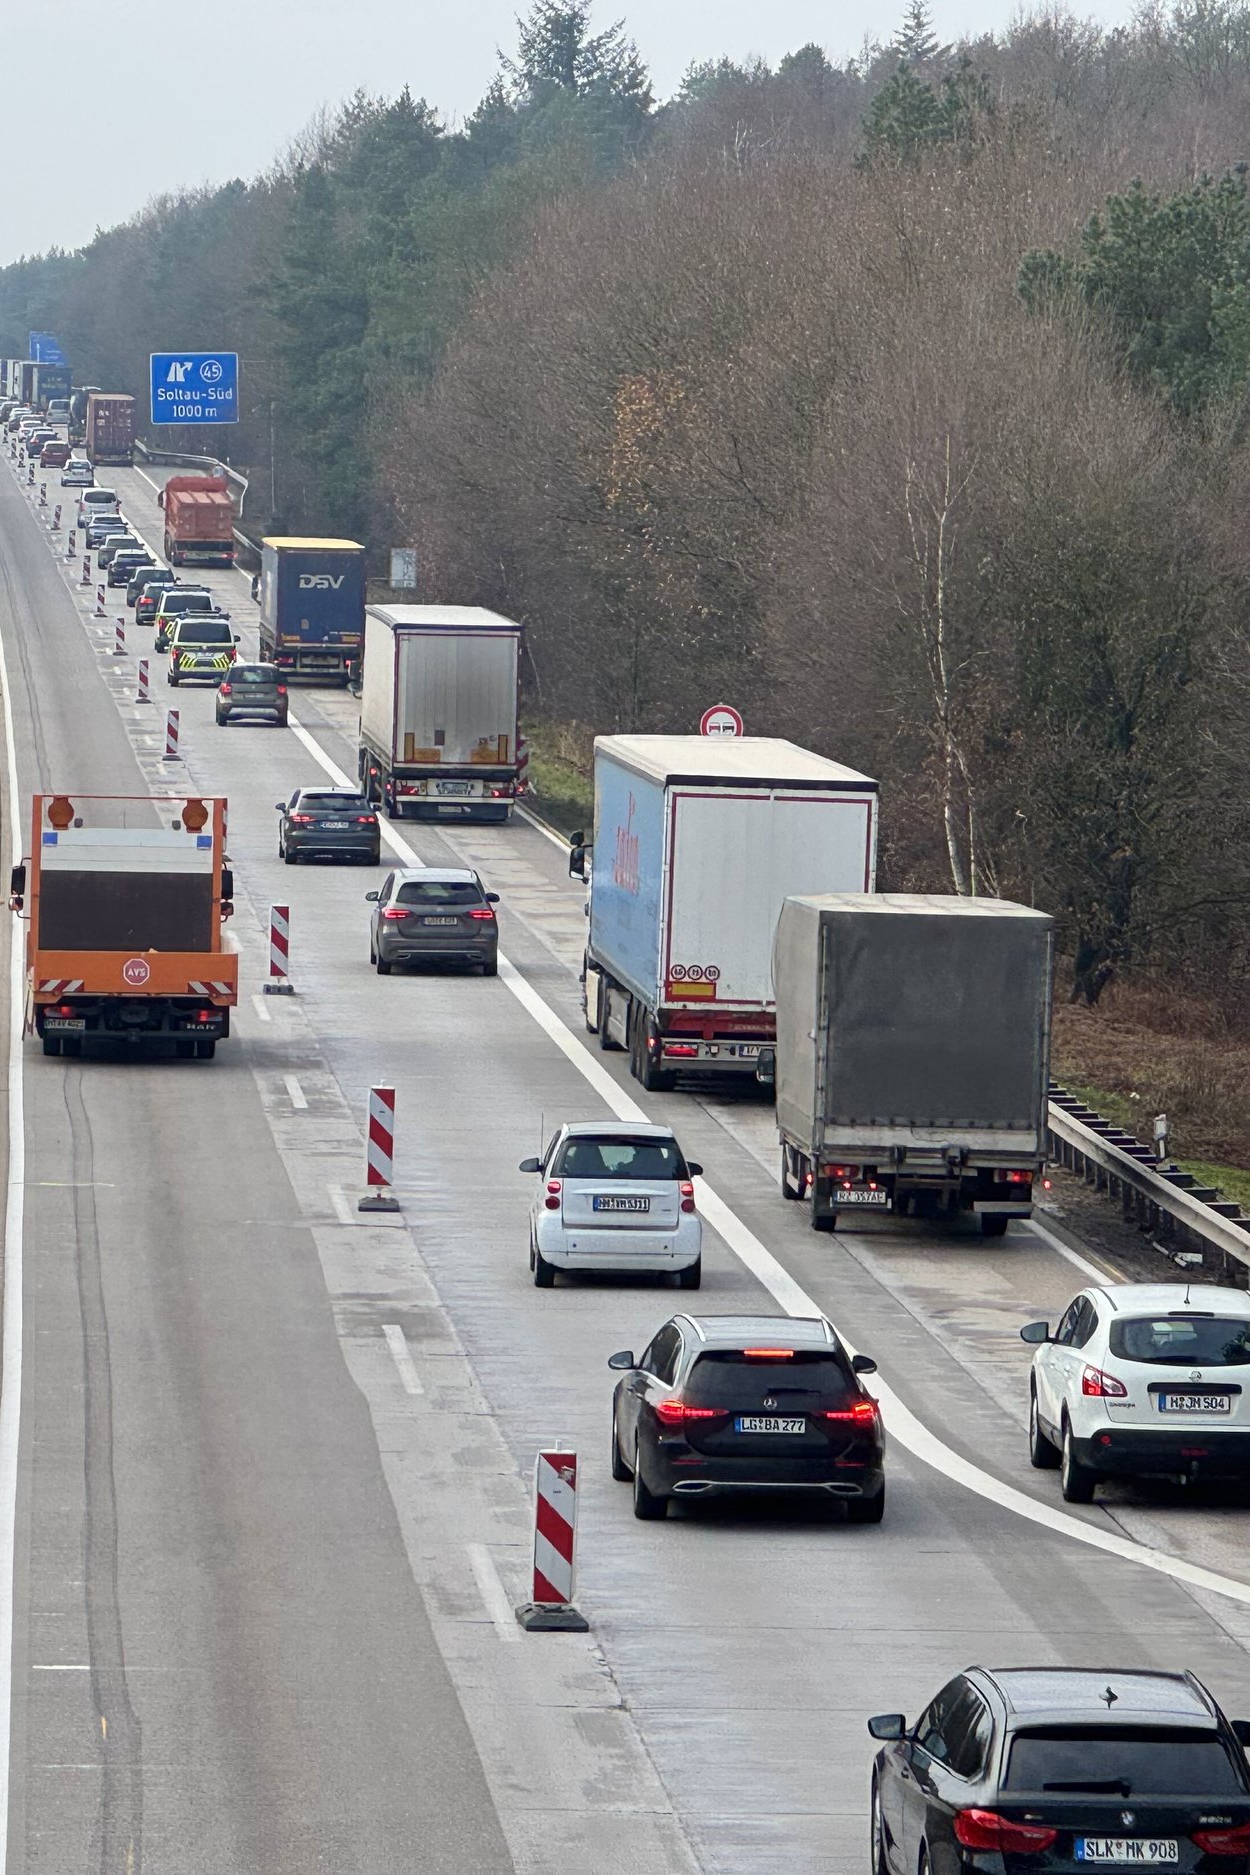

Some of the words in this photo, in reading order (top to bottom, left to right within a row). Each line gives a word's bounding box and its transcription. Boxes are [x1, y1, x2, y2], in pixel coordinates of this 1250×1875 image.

[203, 365, 219, 378] 45
[157, 387, 233, 401] Soltau-Süd
[173, 405, 202, 417] 1000
[205, 407, 217, 417] m
[299, 574, 345, 589] DSV
[741, 1419, 758, 1430] LG
[765, 1419, 780, 1431] BA
[782, 1420, 804, 1432] 277
[1149, 1842, 1177, 1860] 908
